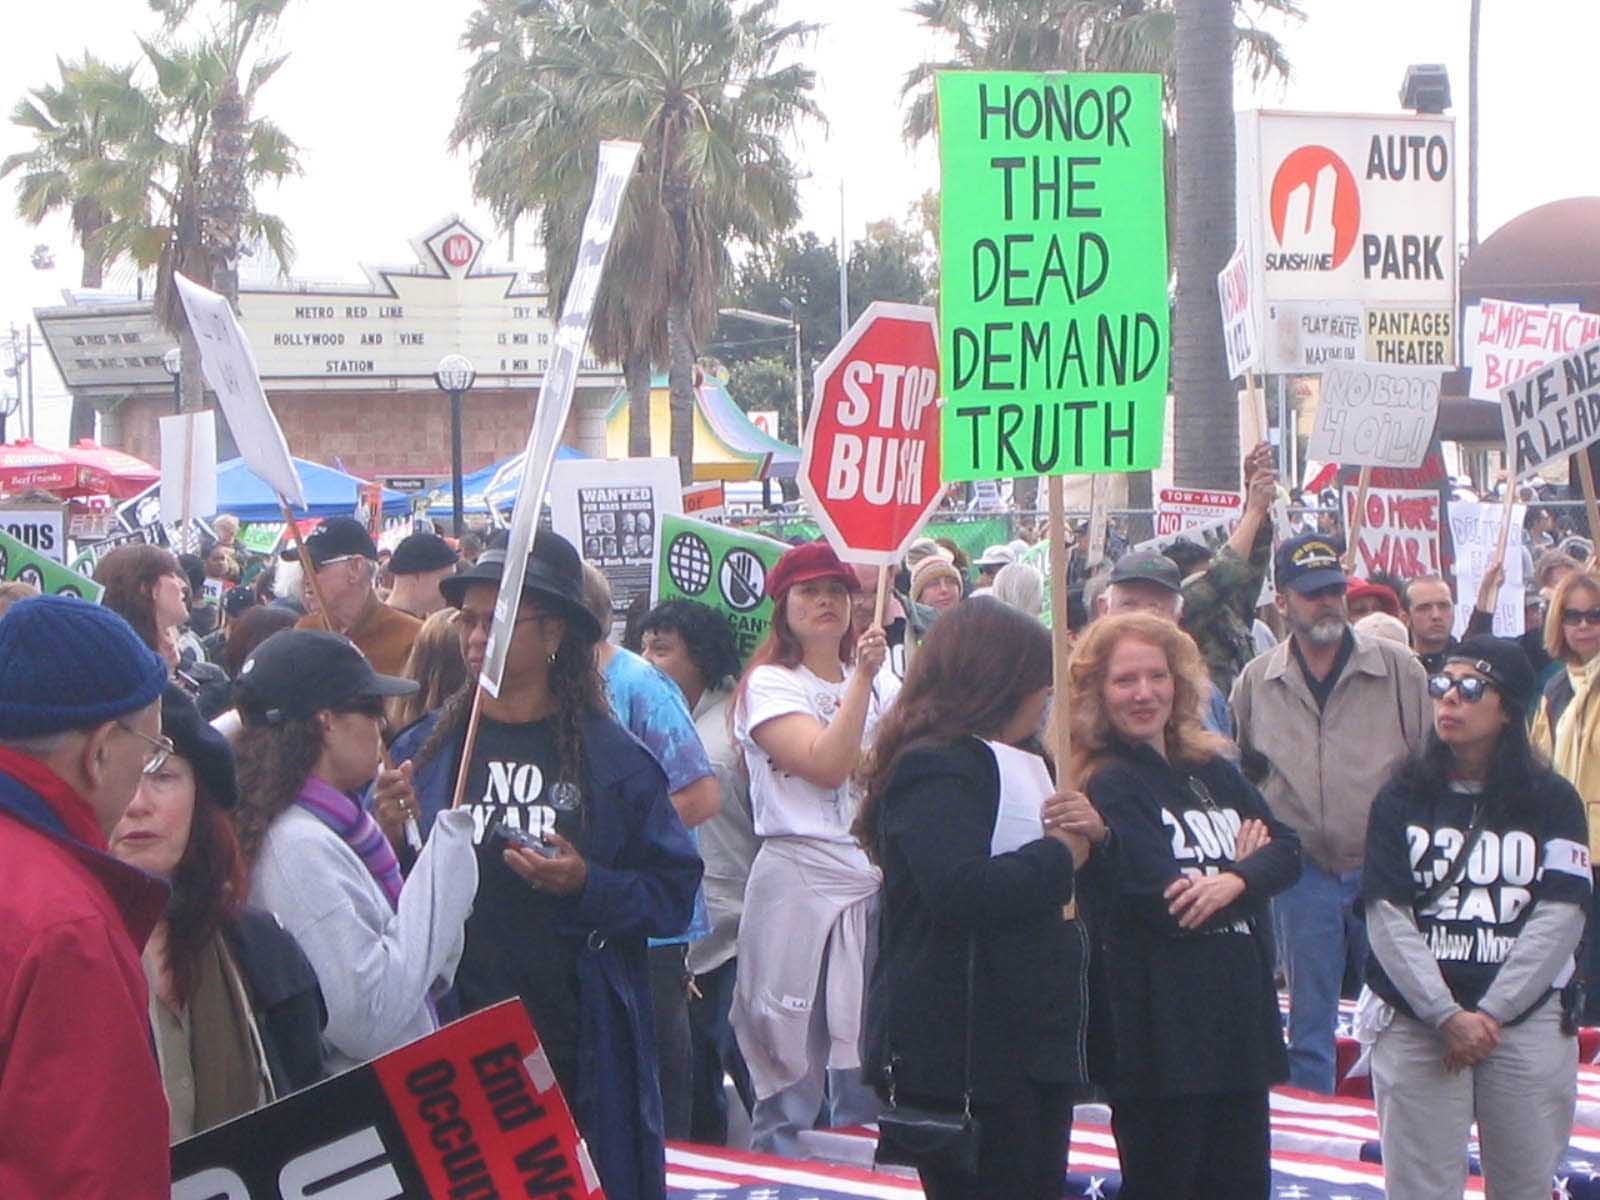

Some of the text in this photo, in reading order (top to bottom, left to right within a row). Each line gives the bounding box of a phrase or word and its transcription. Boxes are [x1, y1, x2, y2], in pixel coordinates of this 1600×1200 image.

[979, 83, 1132, 148] HONOR
[1365, 134, 1448, 182] AUTO
[990, 154, 1102, 221] THE
[973, 231, 1110, 307] DEAD
[1265, 252, 1334, 272] SUNSHINE
[1362, 234, 1444, 280] PARK
[295, 306, 404, 319] METRO RED LINE
[1302, 315, 1330, 336] FLAT
[1368, 311, 1450, 336] PANTAGES
[274, 333, 424, 346] HOLLYWOOD AND VINE
[537, 333, 549, 345] TO
[952, 311, 1161, 391] DEMAND
[1376, 340, 1444, 365] THEATER
[326, 360, 374, 373] STATION
[836, 359, 937, 432] STOP
[1325, 368, 1372, 407] NO
[1507, 368, 1559, 427] WE
[956, 400, 1136, 473] TRUTH
[1323, 407, 1347, 455] 4
[826, 432, 926, 506] BUSH
[1515, 429, 1541, 475] A
[581, 488, 651, 502] WANTED
[1166, 491, 1234, 506] TOW-AWAY
[0, 523, 54, 550] ons
[1160, 513, 1180, 534] NO
[482, 761, 543, 804] NO
[1420, 885, 1532, 924] EAD
[470, 1041, 547, 1133] End
